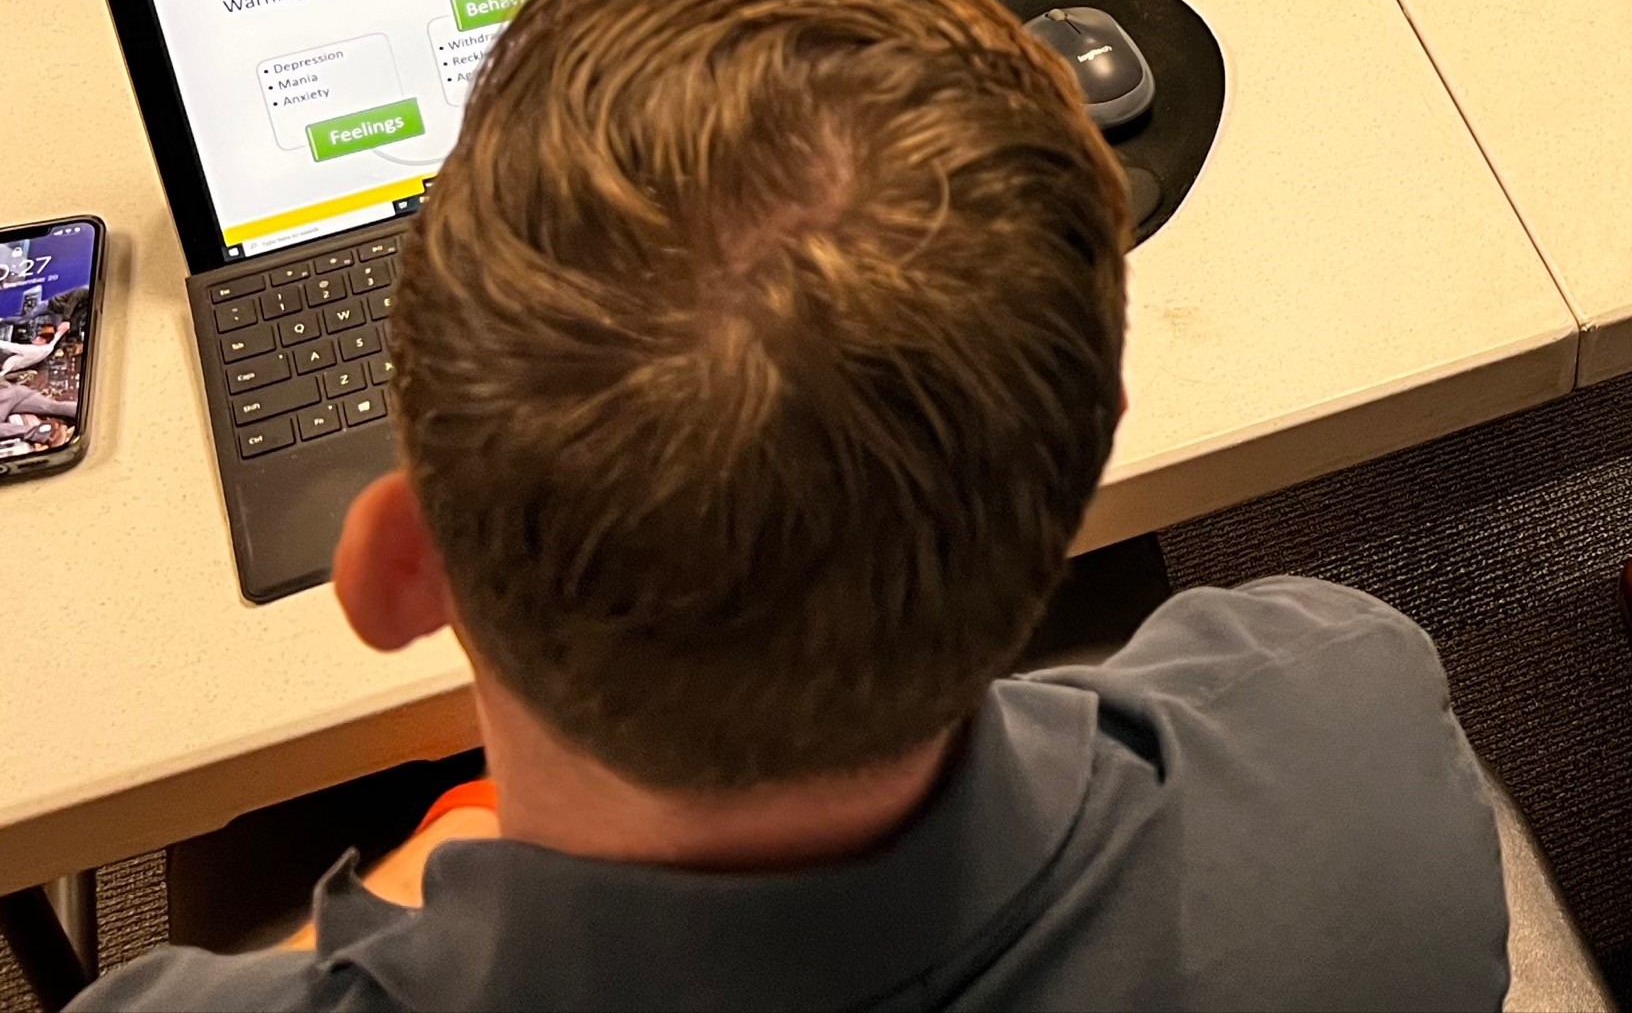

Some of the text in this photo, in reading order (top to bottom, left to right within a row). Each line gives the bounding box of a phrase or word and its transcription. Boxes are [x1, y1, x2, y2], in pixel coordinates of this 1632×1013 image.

[273, 50, 344, 74] Depression
[278, 73, 318, 91] Mania
[283, 89, 330, 106] Anxiety
[328, 115, 405, 146] Feelings
[322, 290, 330, 299] 2
[337, 309, 351, 320] W
[294, 323, 305, 334] Q
[356, 338, 363, 347] S
[310, 351, 320, 361] A
[340, 374, 349, 385] Z
